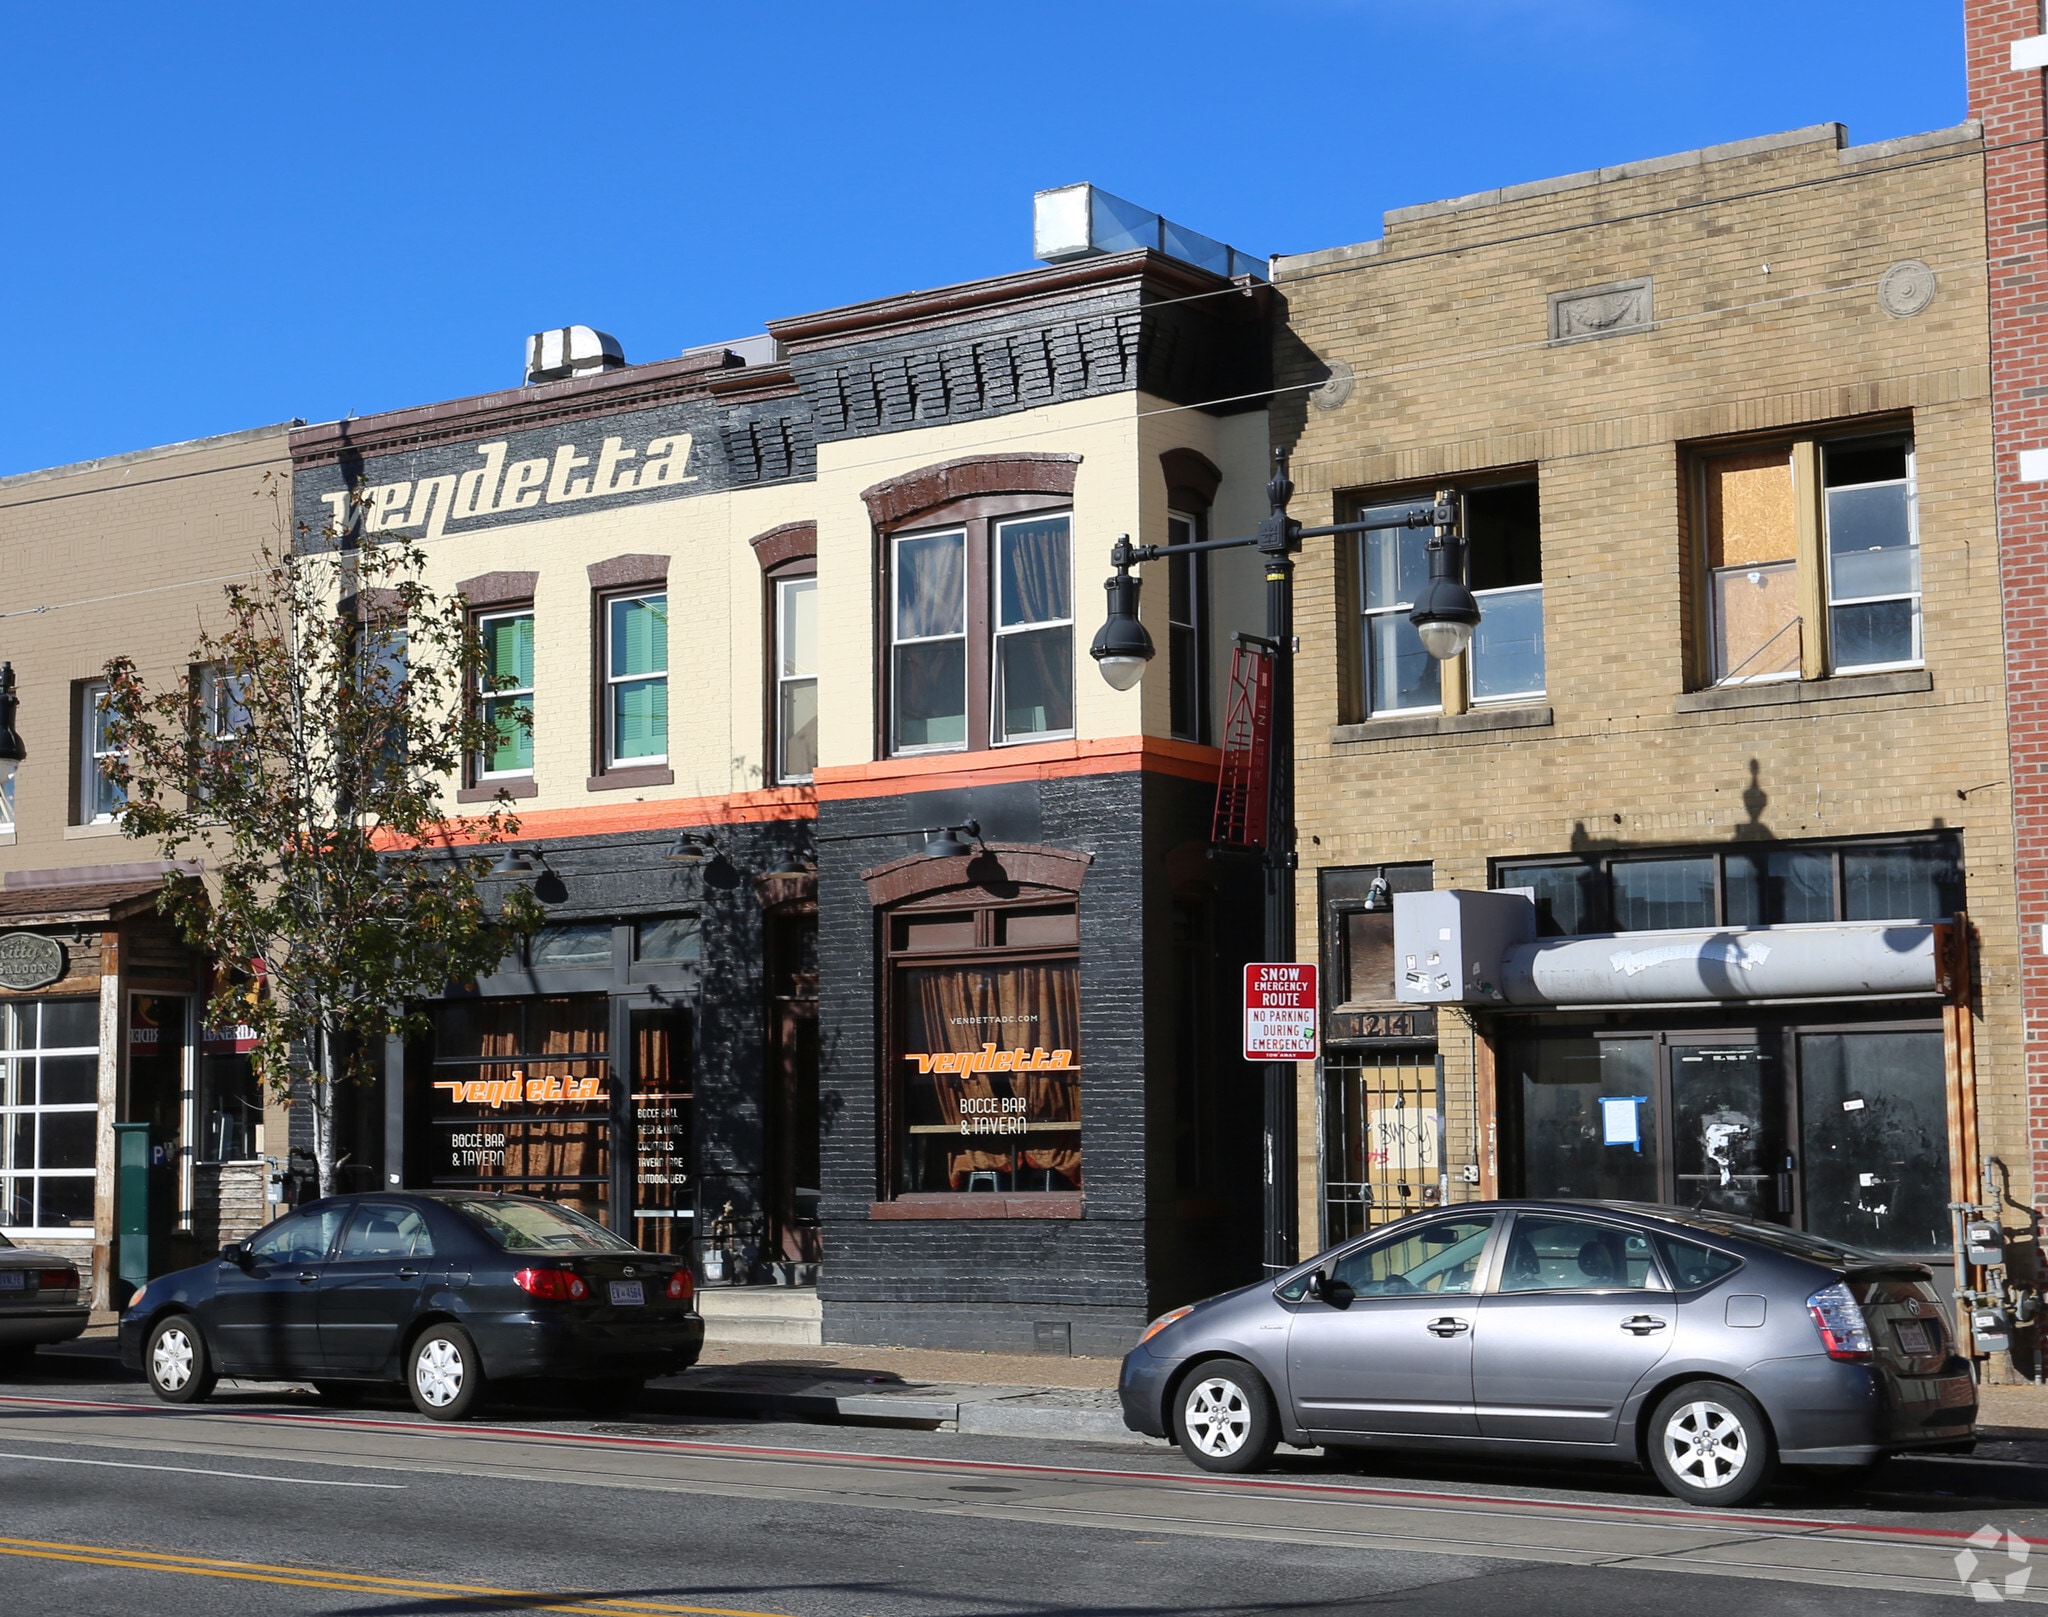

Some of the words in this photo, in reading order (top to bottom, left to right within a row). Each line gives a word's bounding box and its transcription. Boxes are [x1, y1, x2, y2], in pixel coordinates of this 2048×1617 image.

[321, 433, 698, 538] vendetta
[1260, 968, 1300, 981] SNOW
[1254, 982, 1308, 991] EMERGENCY
[1262, 992, 1300, 1006] ROUTE
[949, 1015, 1038, 1025] VENDETTADC.COM
[1253, 1010, 1266, 1022] NO
[1269, 1010, 1310, 1022] PARKING
[1263, 1024, 1300, 1036] DURING
[1352, 1014, 1410, 1037] 1214
[1252, 1039, 1311, 1050] EMERGENCY
[905, 1042, 1081, 1079] vendetta
[433, 1071, 611, 1108] vendetta
[960, 1098, 998, 1114] BOCCE
[1001, 1097, 1027, 1113] BAR
[637, 1108, 660, 1118] BOCCE
[656, 1124, 663, 1134] &
[960, 1119, 971, 1136] &
[972, 1116, 1027, 1135] TAVERN
[452, 1133, 483, 1148] BOCCE
[485, 1133, 506, 1148] BAR
[153, 1145, 164, 1165] P
[452, 1152, 461, 1166] &
[462, 1150, 505, 1166] TAVERN
[637, 1173, 669, 1184] OUTDOOR
